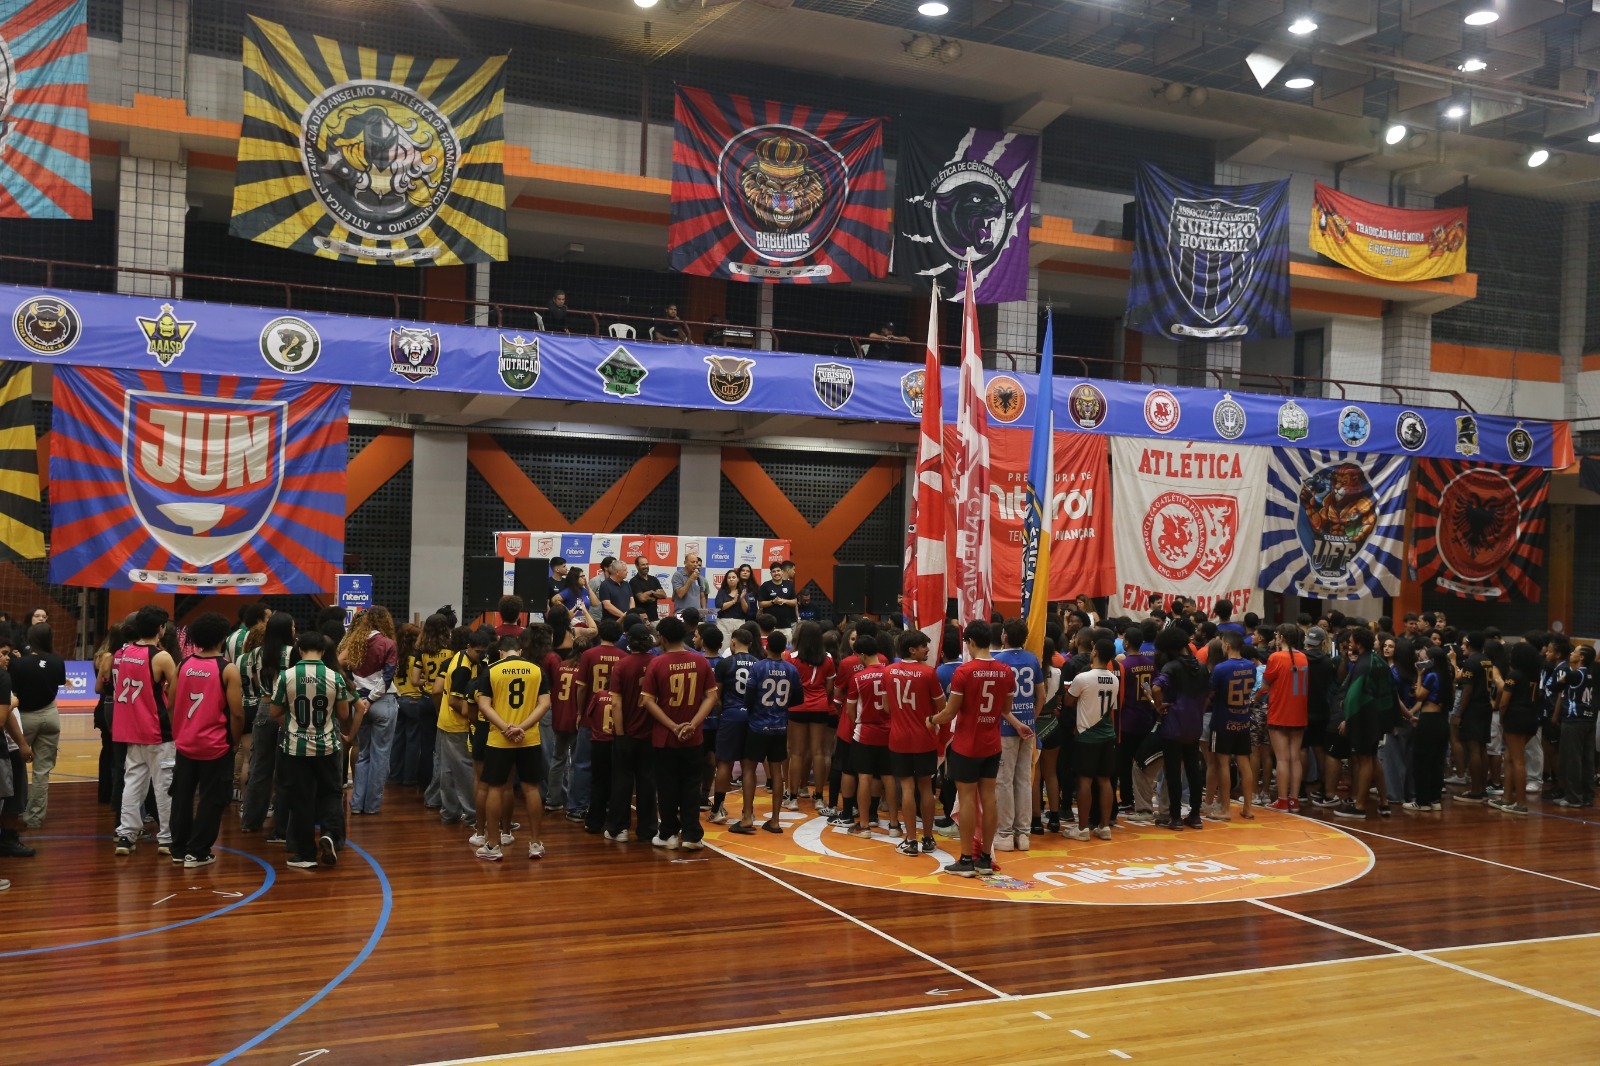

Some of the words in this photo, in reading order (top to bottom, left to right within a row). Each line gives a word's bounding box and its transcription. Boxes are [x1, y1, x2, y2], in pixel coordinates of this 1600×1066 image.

[328, 87, 375, 106] ANSELMO
[391, 91, 434, 121] ATLÉTICA
[432, 118, 446, 134] DE
[931, 165, 957, 190] ATLÉTICA
[957, 163, 966, 171] DE
[967, 160, 994, 177] CIÊNCIAS
[326, 194, 371, 229] ATLÉTICA
[1176, 216, 1256, 238] TURISMO
[1355, 222, 1387, 239] TRADIÇÃO
[1387, 229, 1401, 240] NÃO
[1402, 230, 1406, 241] É
[150, 341, 182, 353] AAASP
[140, 409, 270, 491] JUN
[1138, 441, 1243, 479] ATLÉTICA
[1081, 471, 1091, 481] DE
[1054, 529, 1096, 541] AVANÇAR
[1160, 494, 1190, 509] ATLÉTICA
[1197, 518, 1205, 559] ORLANDO
[1312, 539, 1357, 571] UFF
[118, 677, 144, 704] 27
[508, 678, 526, 710] 8
[558, 673, 574, 701] 3
[669, 672, 698, 707] 91
[761, 678, 791, 707] 29
[893, 677, 917, 711] 14
[980, 680, 996, 714] 5
[188, 692, 204, 719] 7
[294, 694, 329, 729] 08
